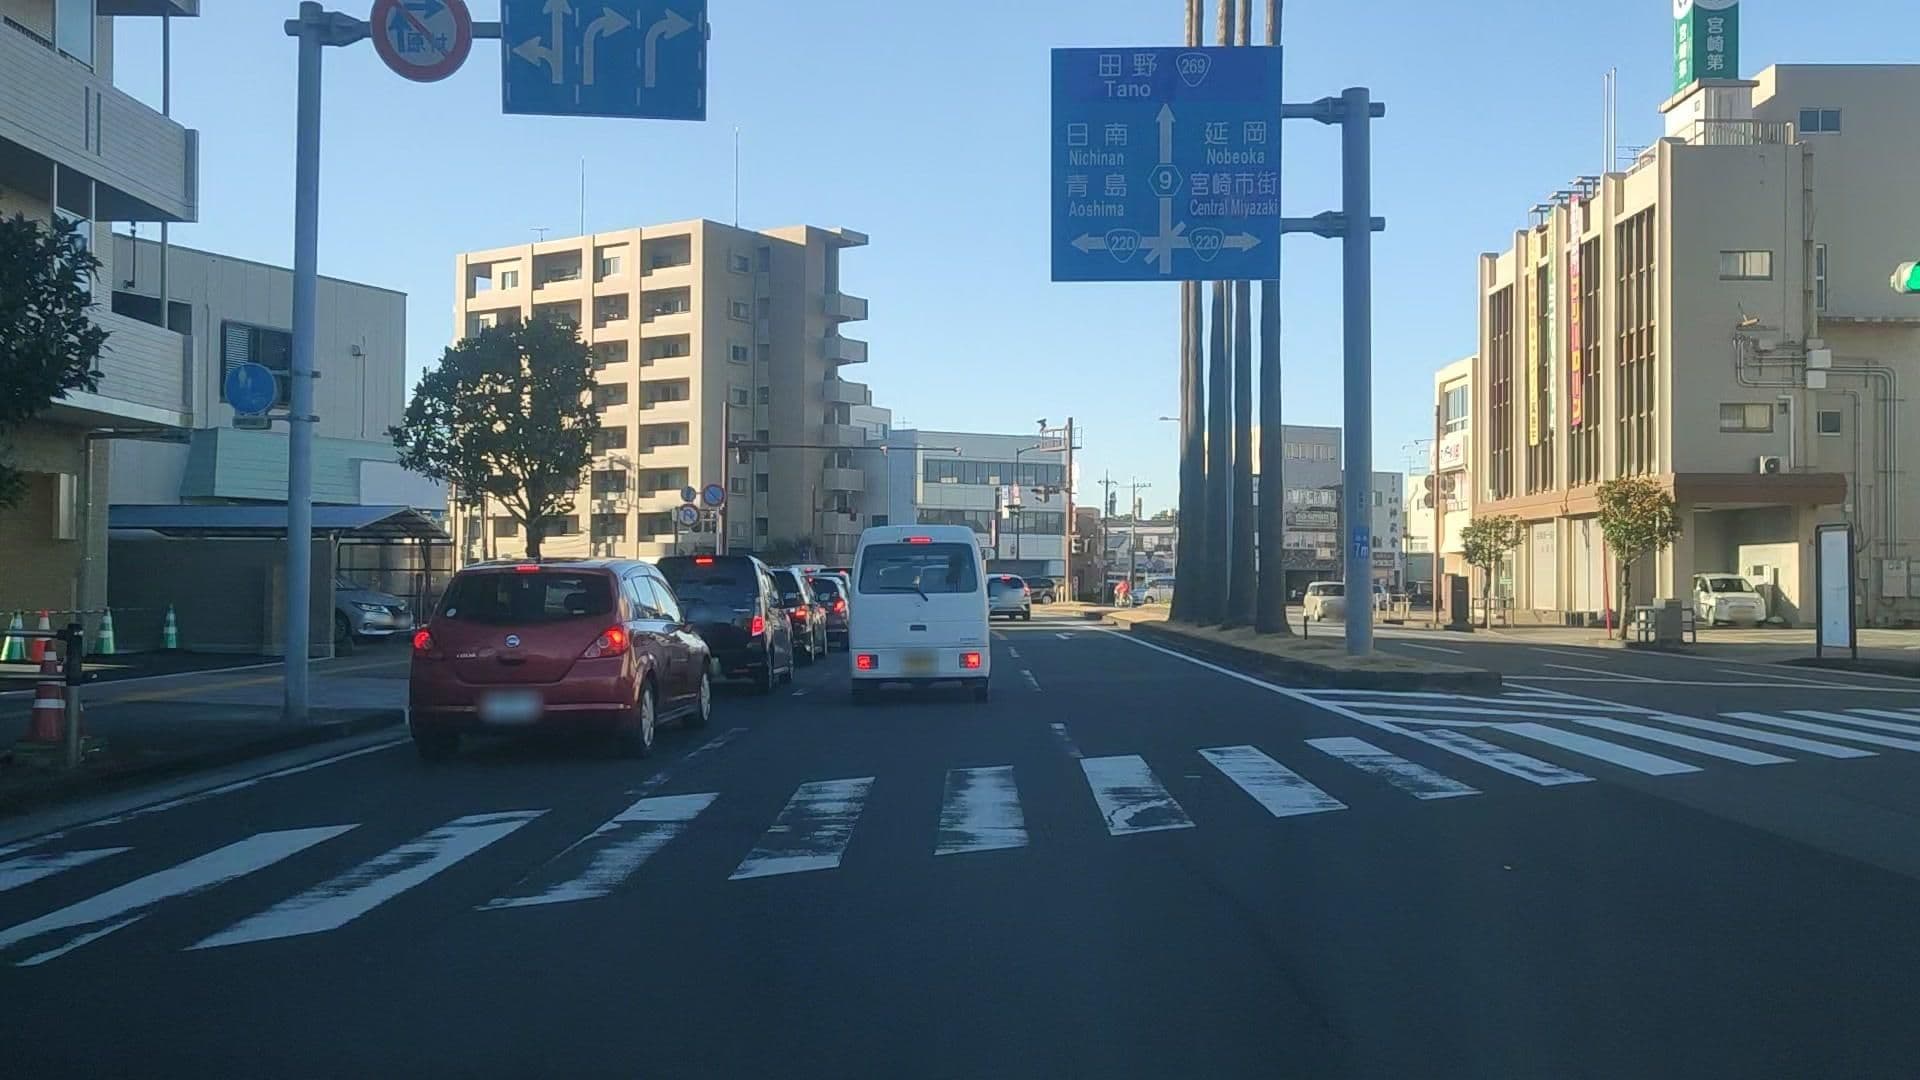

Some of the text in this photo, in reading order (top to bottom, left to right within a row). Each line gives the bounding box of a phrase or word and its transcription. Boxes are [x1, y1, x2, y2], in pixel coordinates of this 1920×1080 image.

[1099, 53, 1158, 78] 田野
[1181, 58, 1206, 75] 269
[1104, 80, 1151, 98] Tano
[1067, 123, 1129, 147] 日南
[1204, 121, 1267, 145] 延岡
[1069, 149, 1125, 166] Nichinan
[1207, 147, 1265, 165] Nobeoka
[1065, 174, 1128, 198] 青島
[1159, 171, 1172, 190] 9
[1190, 171, 1279, 197] 宮崎市街
[1068, 200, 1125, 217] Aoshima
[1189, 198, 1279, 219] Central Miyazaki
[1111, 236, 1136, 251] 220
[1194, 235, 1219, 250] 220
